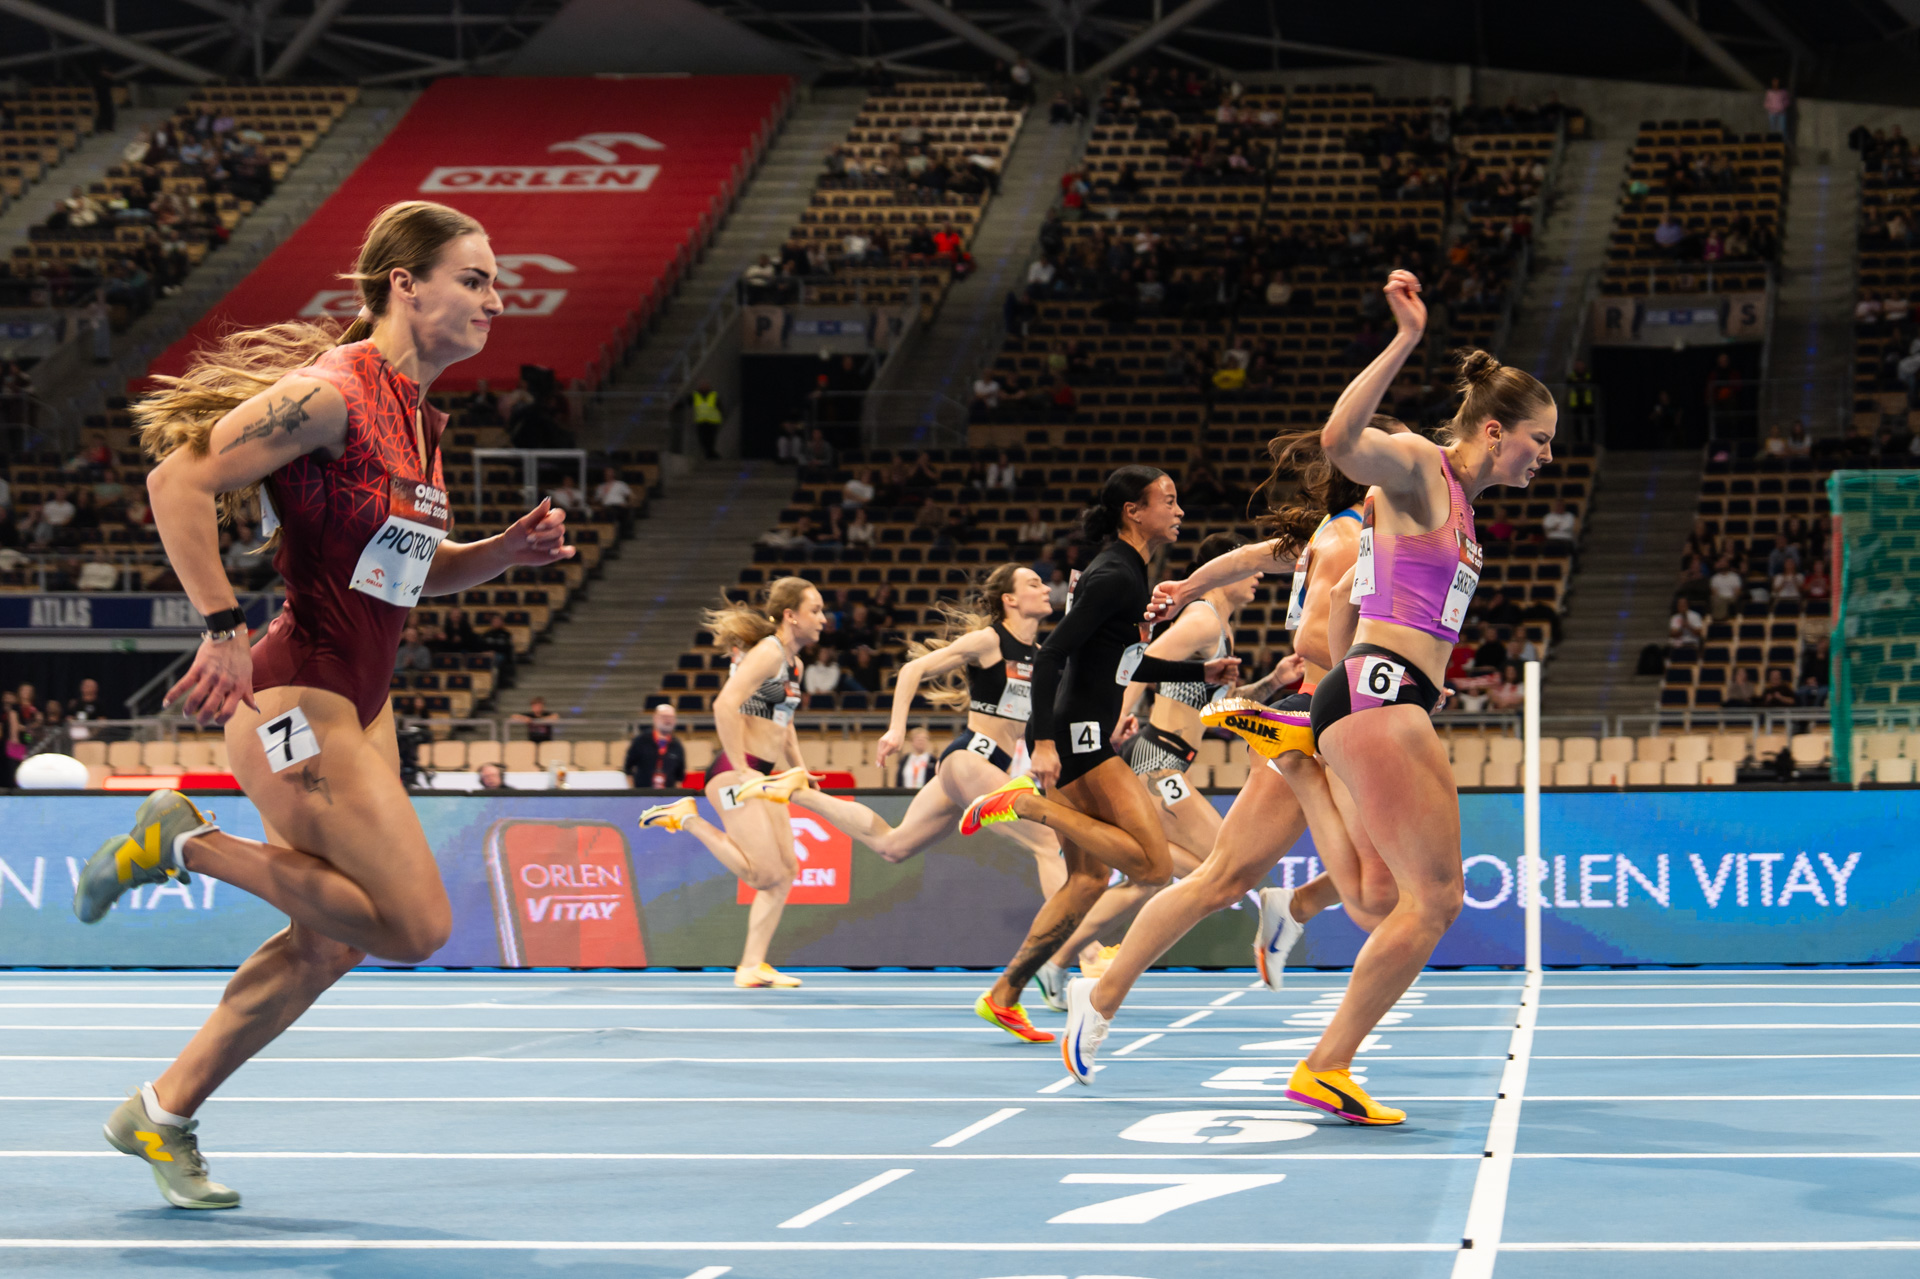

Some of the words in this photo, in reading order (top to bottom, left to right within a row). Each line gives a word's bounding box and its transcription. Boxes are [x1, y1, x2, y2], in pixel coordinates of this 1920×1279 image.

[437, 167, 643, 188] ORLEN
[30, 598, 92, 627] ATLAS
[1368, 662, 1394, 695] 6
[267, 716, 293, 762] 7
[1077, 726, 1095, 749] 4
[1225, 716, 1281, 742] NITRO
[973, 738, 990, 755] 2
[725, 788, 737, 806] 1
[1164, 778, 1183, 800] 3
[520, 864, 623, 888] ORLEN
[1462, 853, 1670, 910] ORLEN
[1688, 852, 1862, 908] VITAY
[526, 895, 622, 922] VITAY
[1118, 1110, 1325, 1144] 6
[1045, 1174, 1287, 1224] 7
